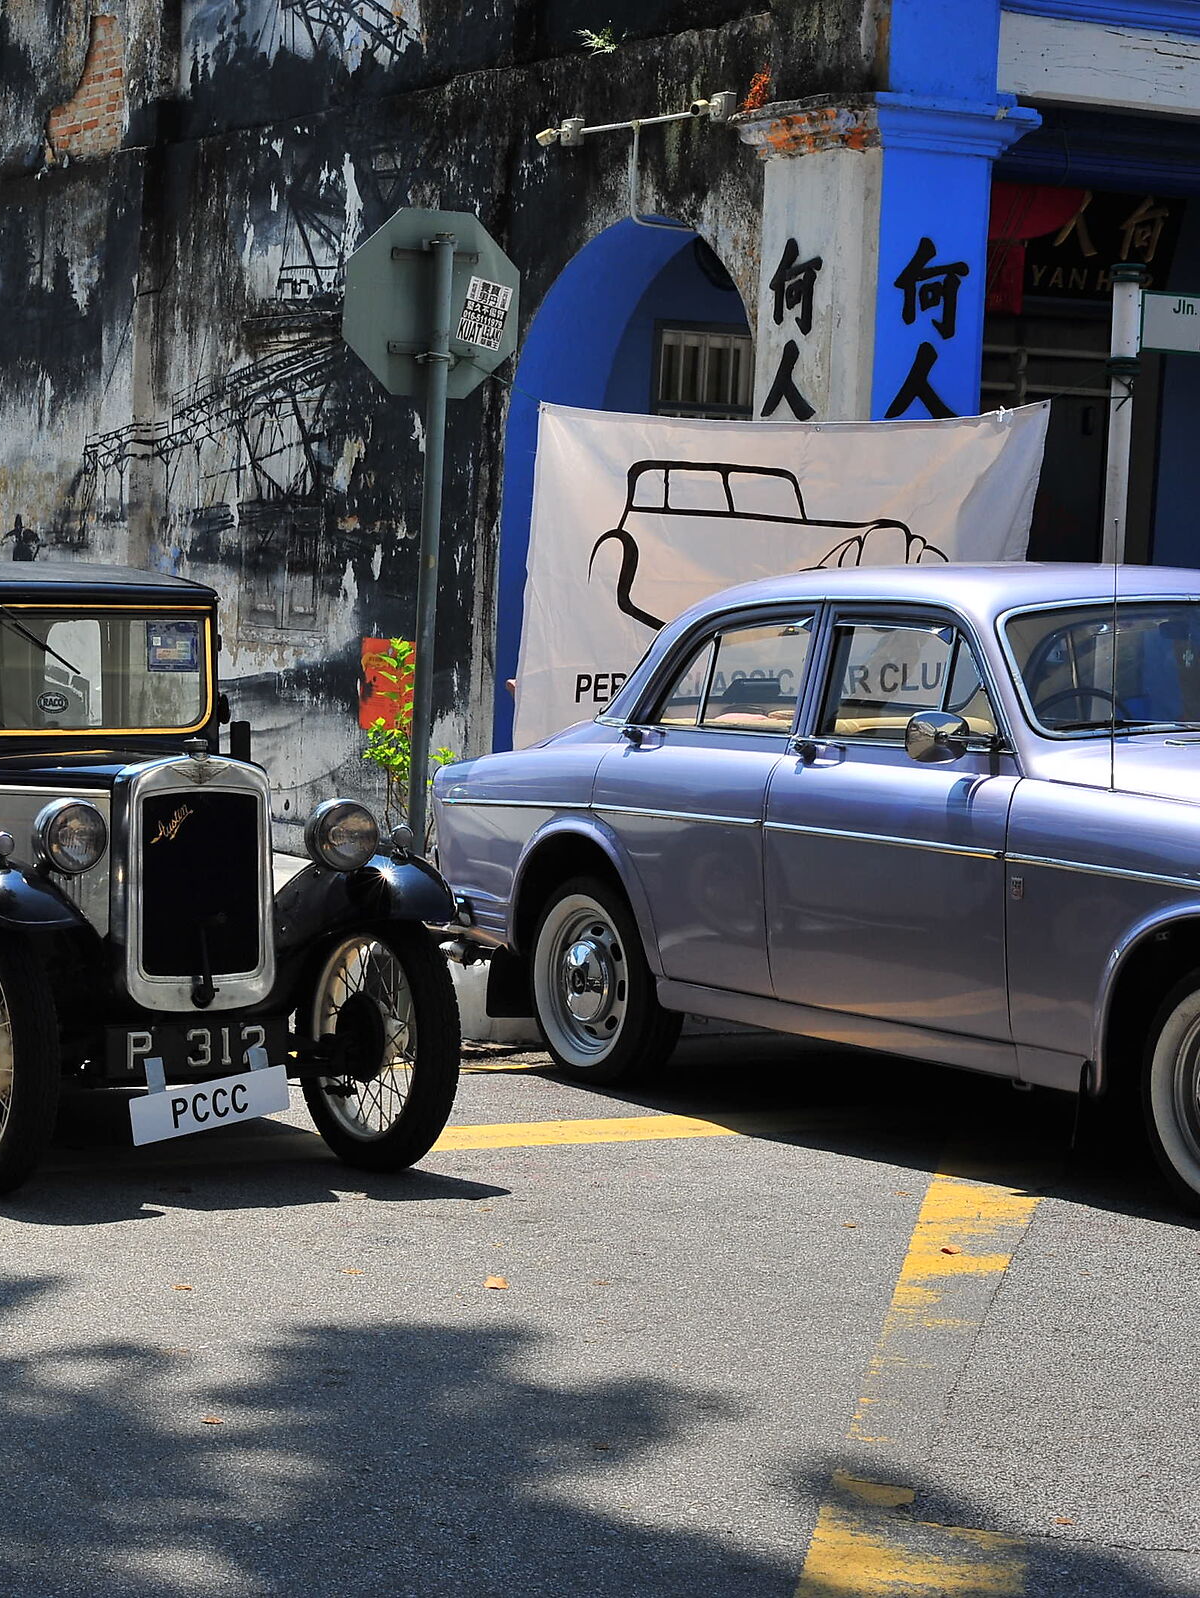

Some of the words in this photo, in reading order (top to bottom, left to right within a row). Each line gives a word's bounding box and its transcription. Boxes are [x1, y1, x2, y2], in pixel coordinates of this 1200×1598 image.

[1031, 264, 1089, 291] YAN
[1172, 299, 1198, 316] Jln.
[457, 318, 483, 344] KUAT
[879, 661, 947, 693] CLU
[126, 1031, 153, 1070] P
[170, 1083, 249, 1129] PCCC
